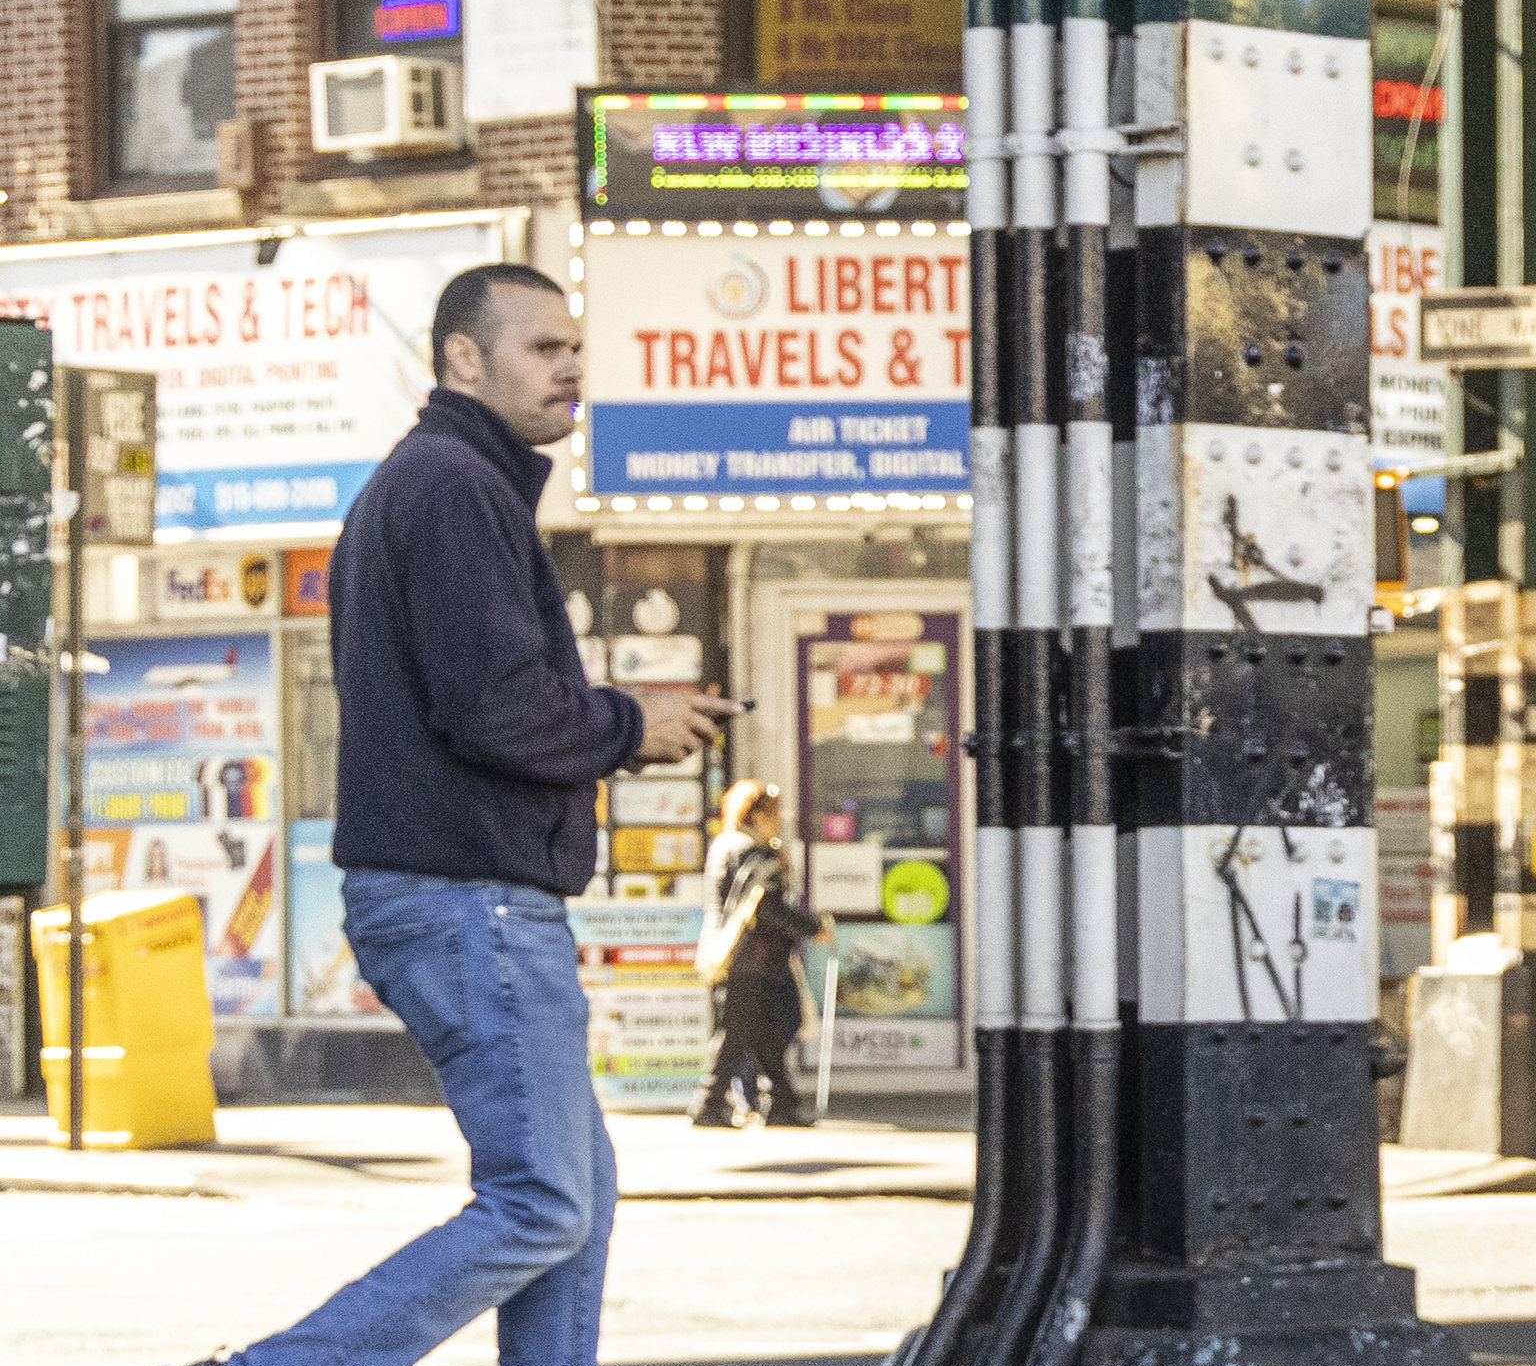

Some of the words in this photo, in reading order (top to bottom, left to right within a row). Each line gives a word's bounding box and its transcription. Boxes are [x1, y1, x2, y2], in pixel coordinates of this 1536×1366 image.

[786, 254, 966, 315] LIBERT
[1371, 244, 1438, 296] IBE
[72, 282, 224, 353] TRAVELS
[238, 277, 262, 344] &
[280, 272, 373, 340] TECH
[1434, 314, 1483, 345] ONE
[634, 328, 865, 389] TRAVELS
[888, 328, 923, 388] &
[788, 415, 837, 446] AIR
[840, 415, 931, 446] TICKET
[625, 451, 720, 482] MONEY
[167, 566, 231, 603] FedEx
